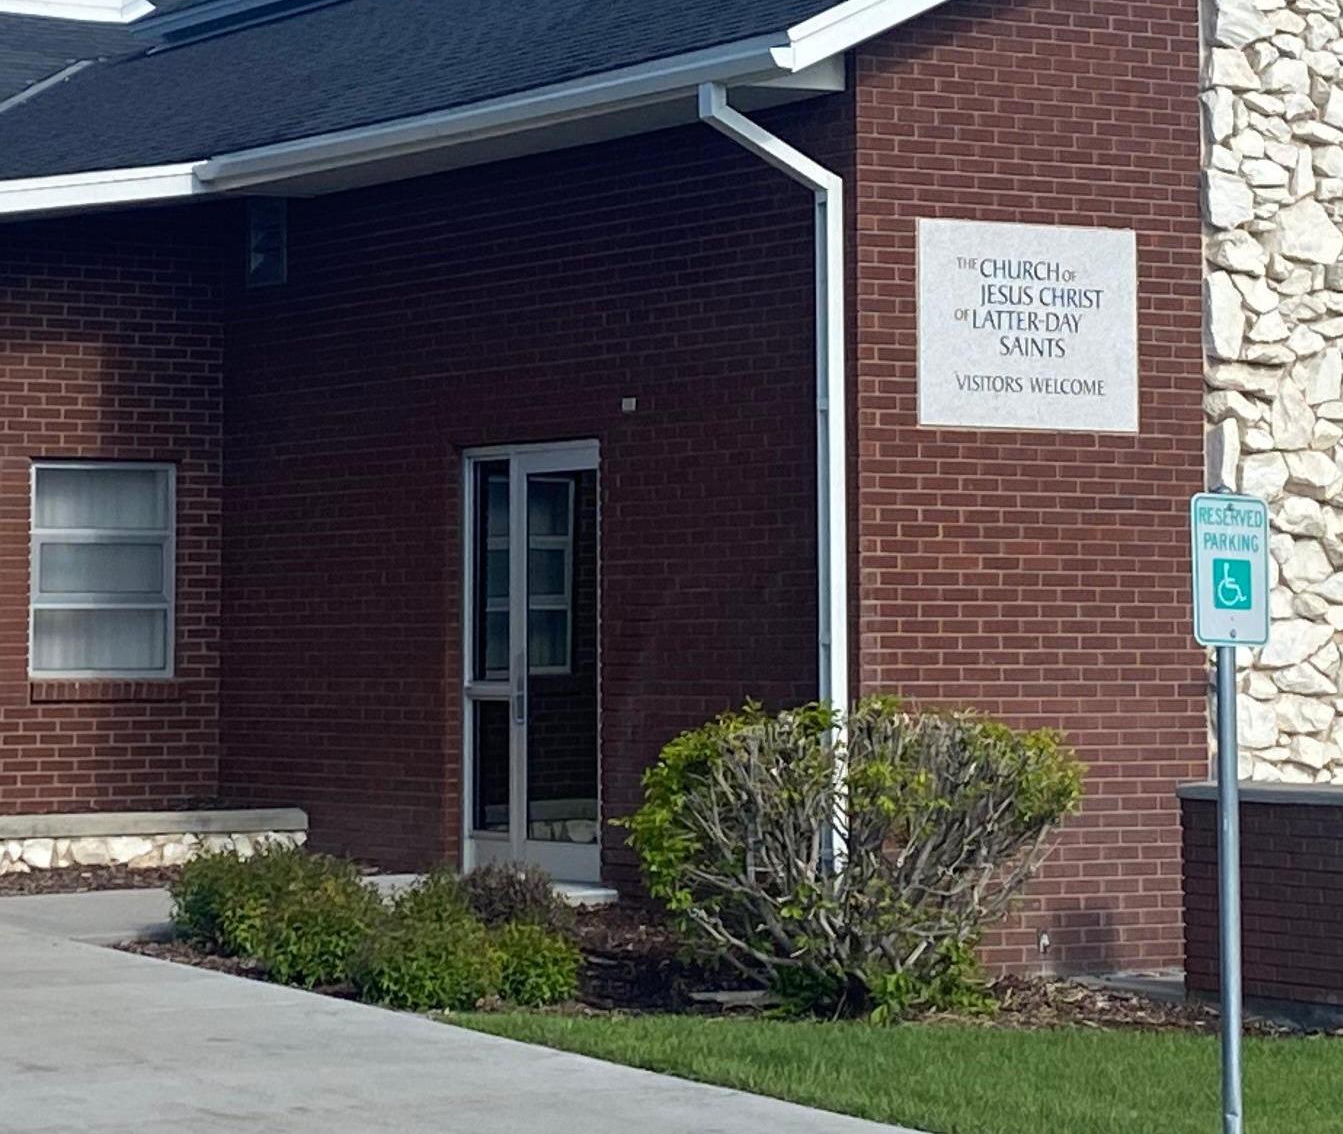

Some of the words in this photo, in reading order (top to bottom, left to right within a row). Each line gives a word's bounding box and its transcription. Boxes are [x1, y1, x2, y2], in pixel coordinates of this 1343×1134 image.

[957, 257, 978, 270] THE
[980, 258, 1060, 282] CHURCH
[1062, 269, 1077, 282] OF
[980, 284, 1033, 307] JESUS
[1039, 286, 1104, 309] CHRIST
[954, 308, 969, 322] OF
[972, 309, 1083, 333] LATTER-DAY
[999, 336, 1066, 358] SAINTS
[955, 372, 1023, 393] VISITORS
[1030, 377, 1105, 396] WELCOME
[1198, 506, 1263, 528] RESERVED
[1203, 532, 1259, 553] PARKING
